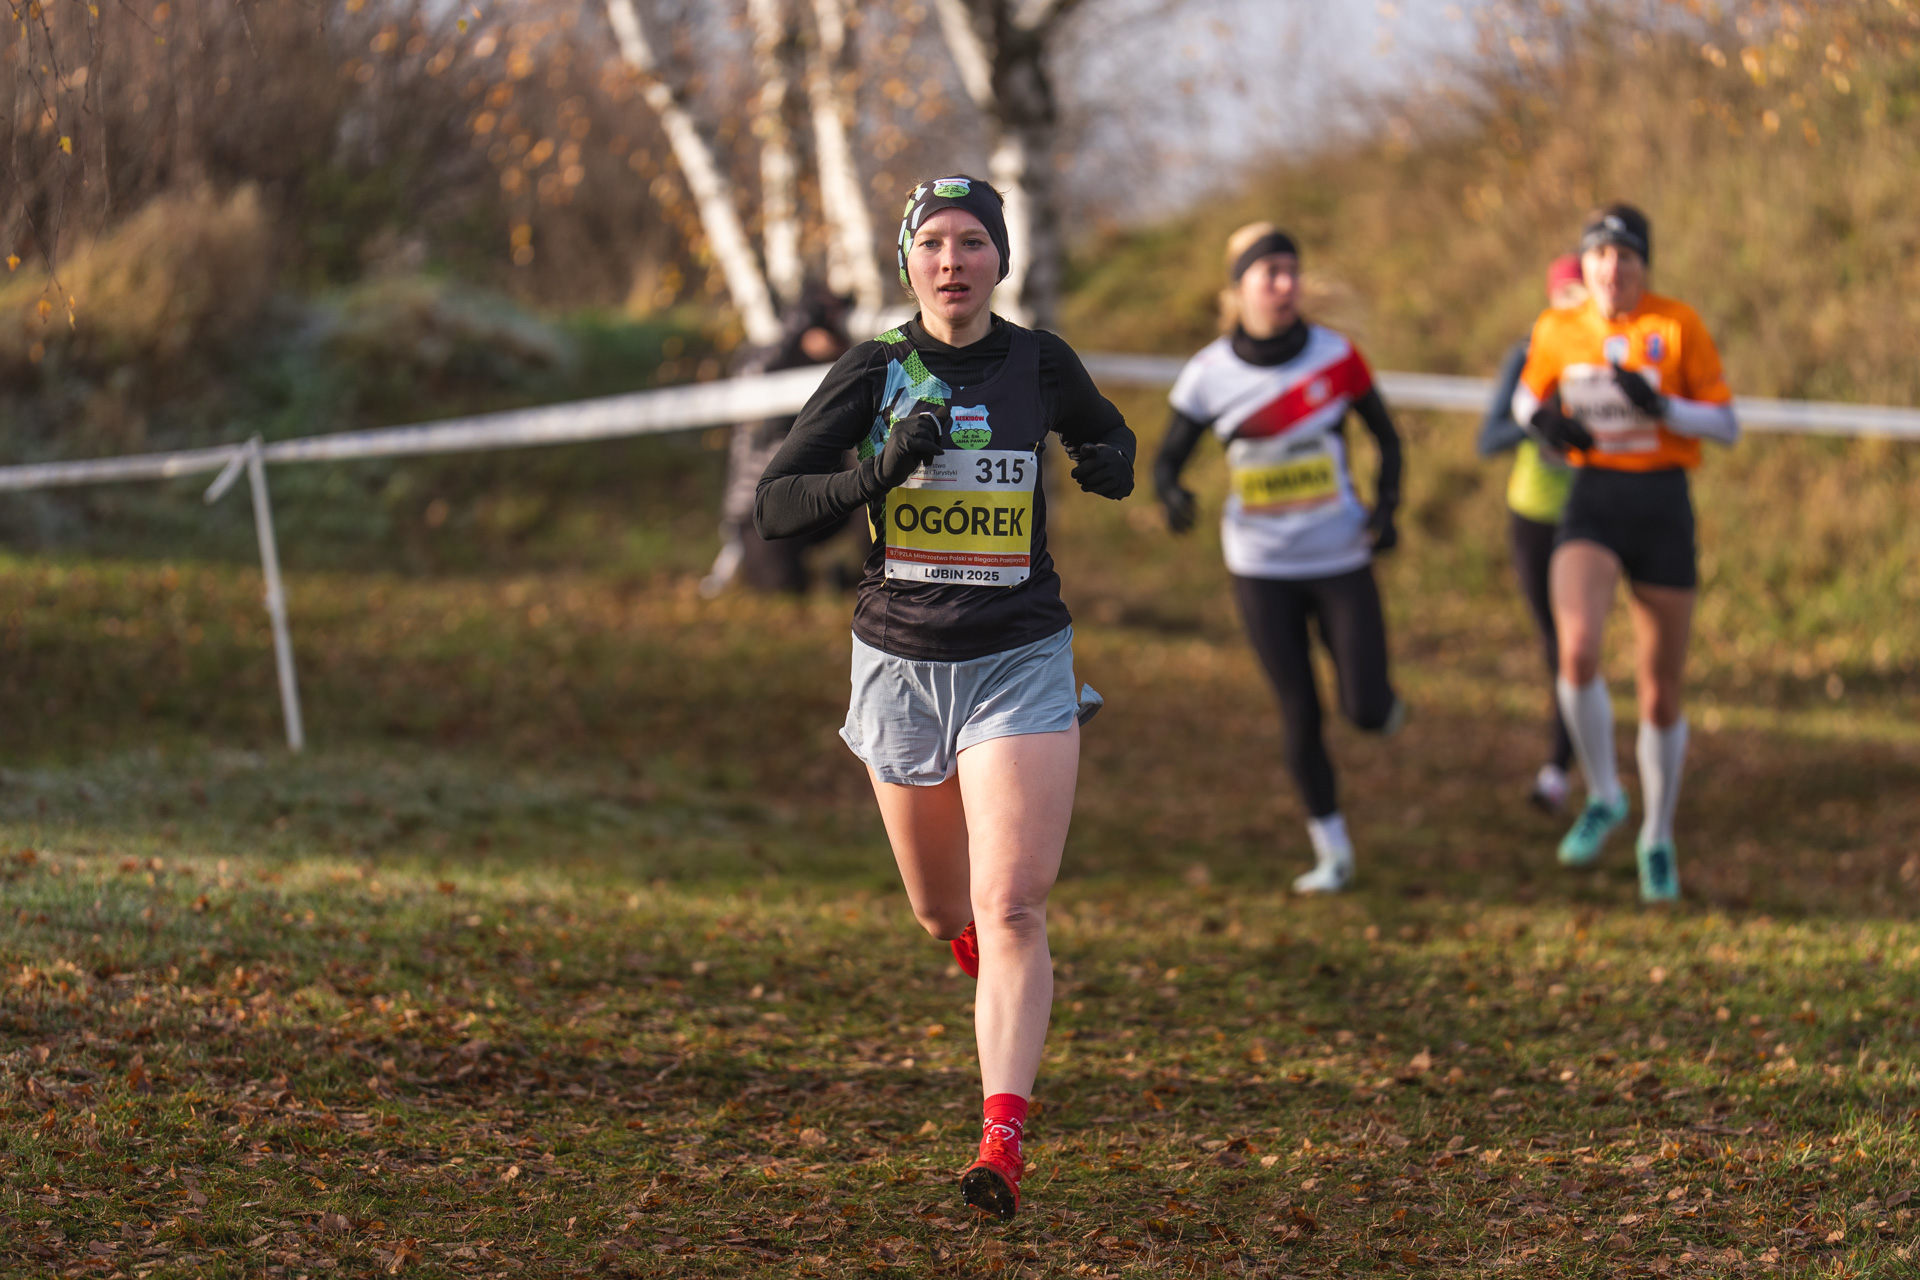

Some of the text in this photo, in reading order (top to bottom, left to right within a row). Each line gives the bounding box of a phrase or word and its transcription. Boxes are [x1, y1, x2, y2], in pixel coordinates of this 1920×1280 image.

[975, 457, 1025, 484] 315
[894, 500, 1026, 536] OGÓREK
[914, 552, 948, 561] Mistrzostwa
[974, 556, 998, 564] Biegach
[925, 568, 999, 581] LUBIN 2025
